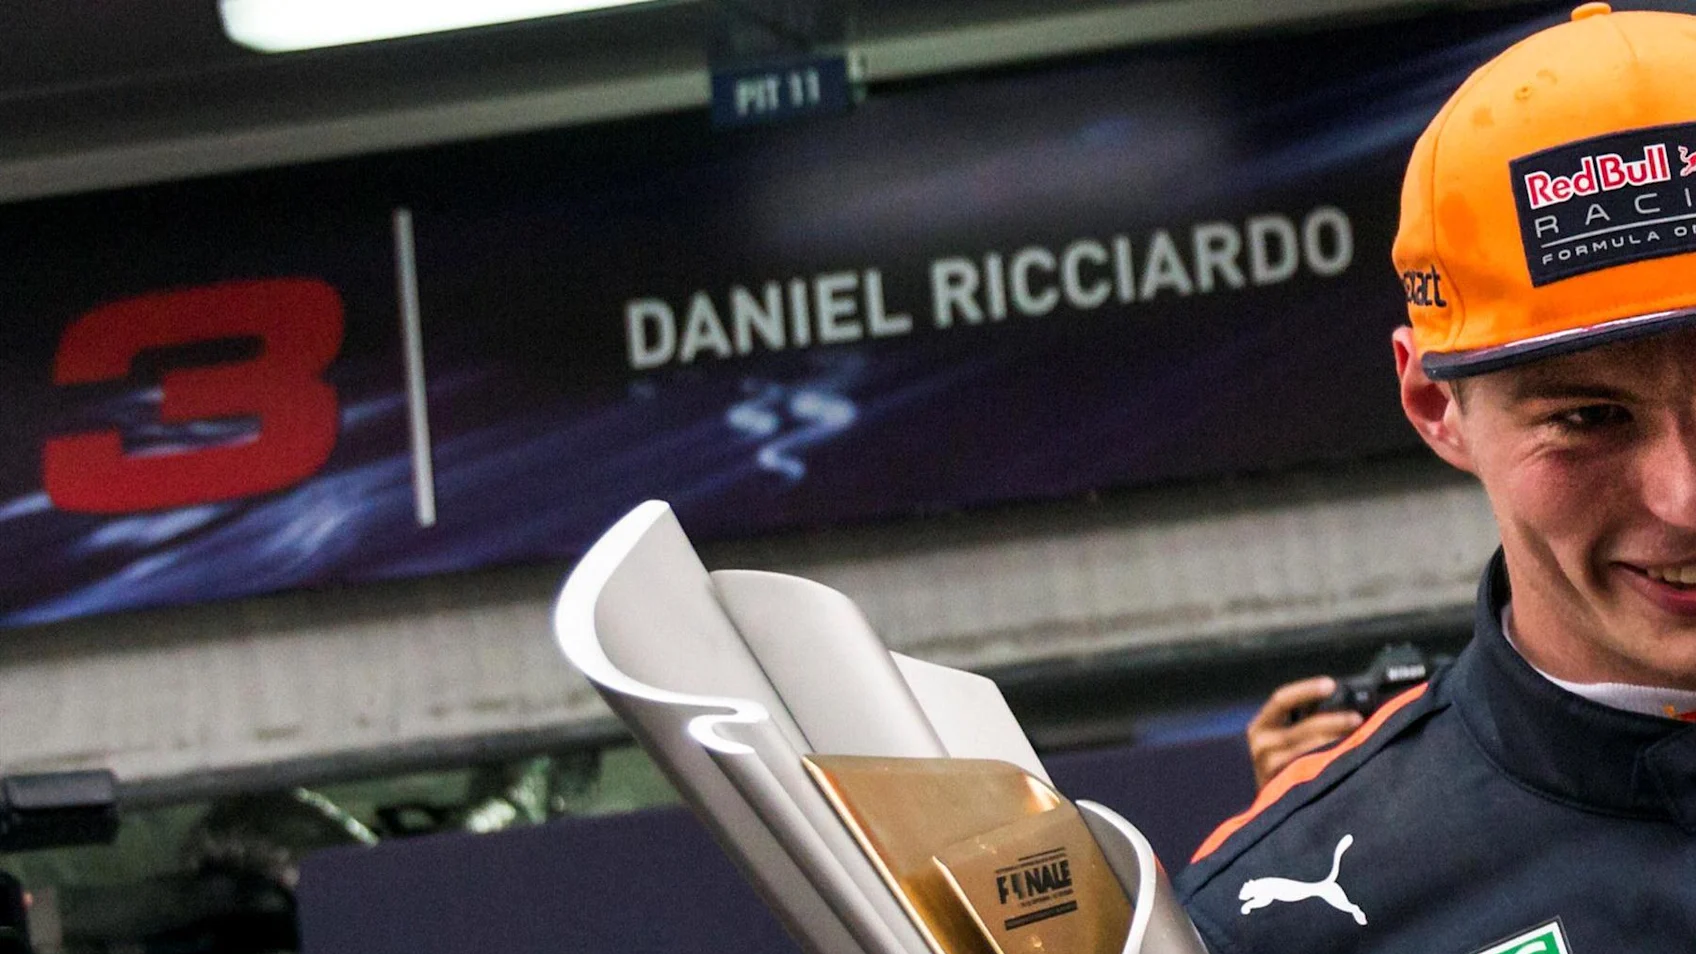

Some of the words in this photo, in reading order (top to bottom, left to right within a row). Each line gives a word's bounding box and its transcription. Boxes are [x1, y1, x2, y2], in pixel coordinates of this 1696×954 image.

[736, 73, 780, 116] PIT
[788, 67, 820, 107] 11
[1524, 156, 1598, 209] Red
[1597, 143, 1671, 191] Bull
[1542, 230, 1660, 265] FORMULA
[625, 269, 912, 371] DANIEL
[931, 207, 1355, 330] RICCIARDO
[43, 277, 344, 514] 3
